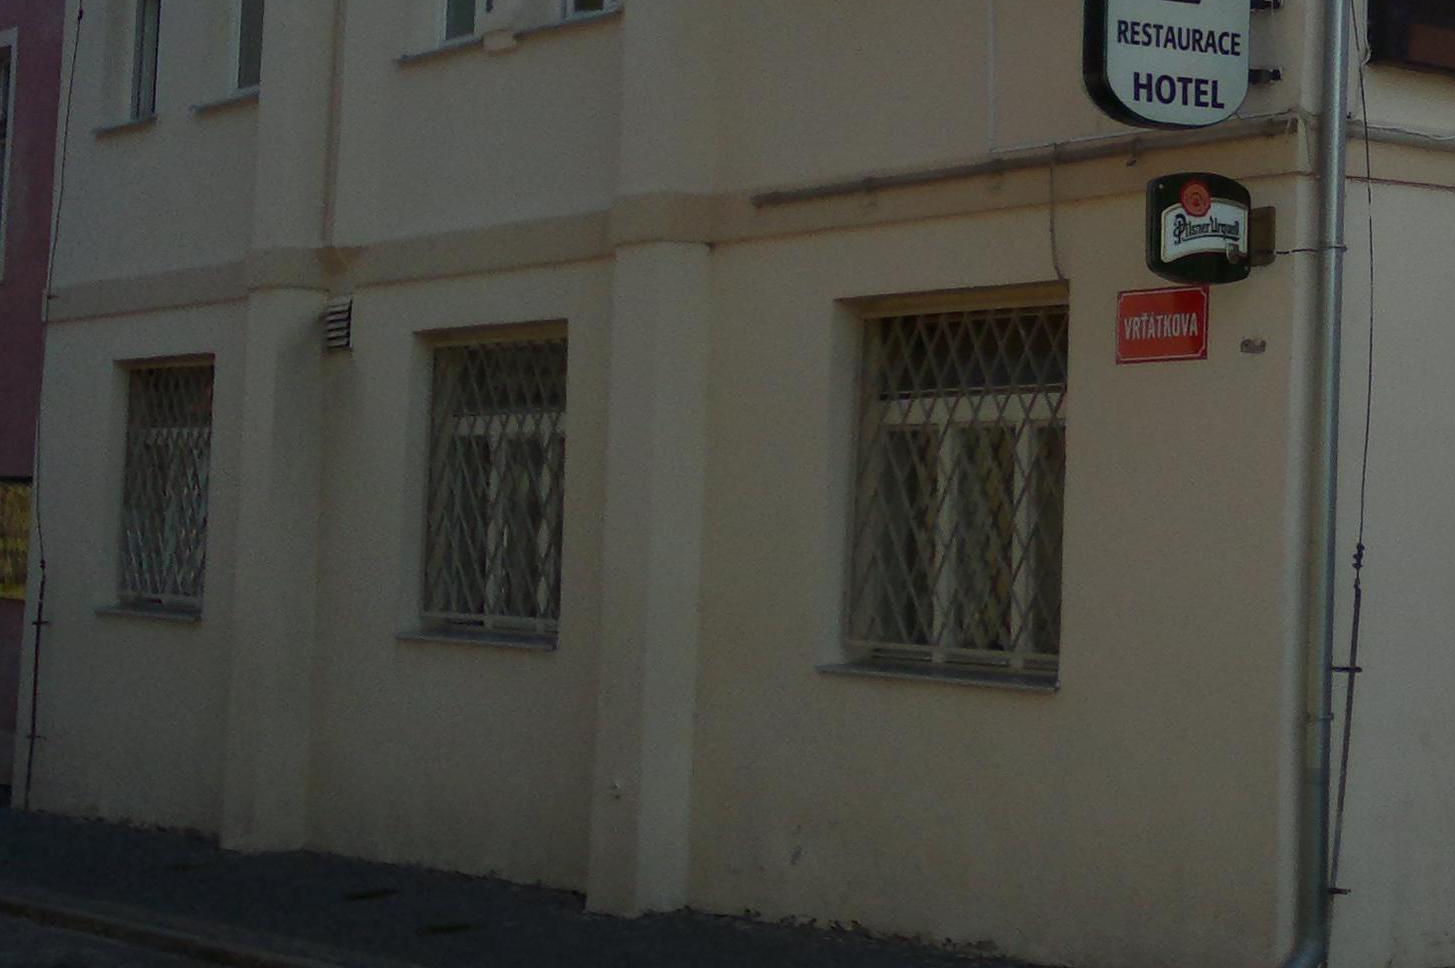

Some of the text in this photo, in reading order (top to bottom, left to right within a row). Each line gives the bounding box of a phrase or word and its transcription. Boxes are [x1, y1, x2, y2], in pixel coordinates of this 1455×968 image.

[1117, 19, 1241, 56] RESTAURACE
[1133, 72, 1225, 109] HOTEL
[1173, 213, 1210, 244] Pilsner
